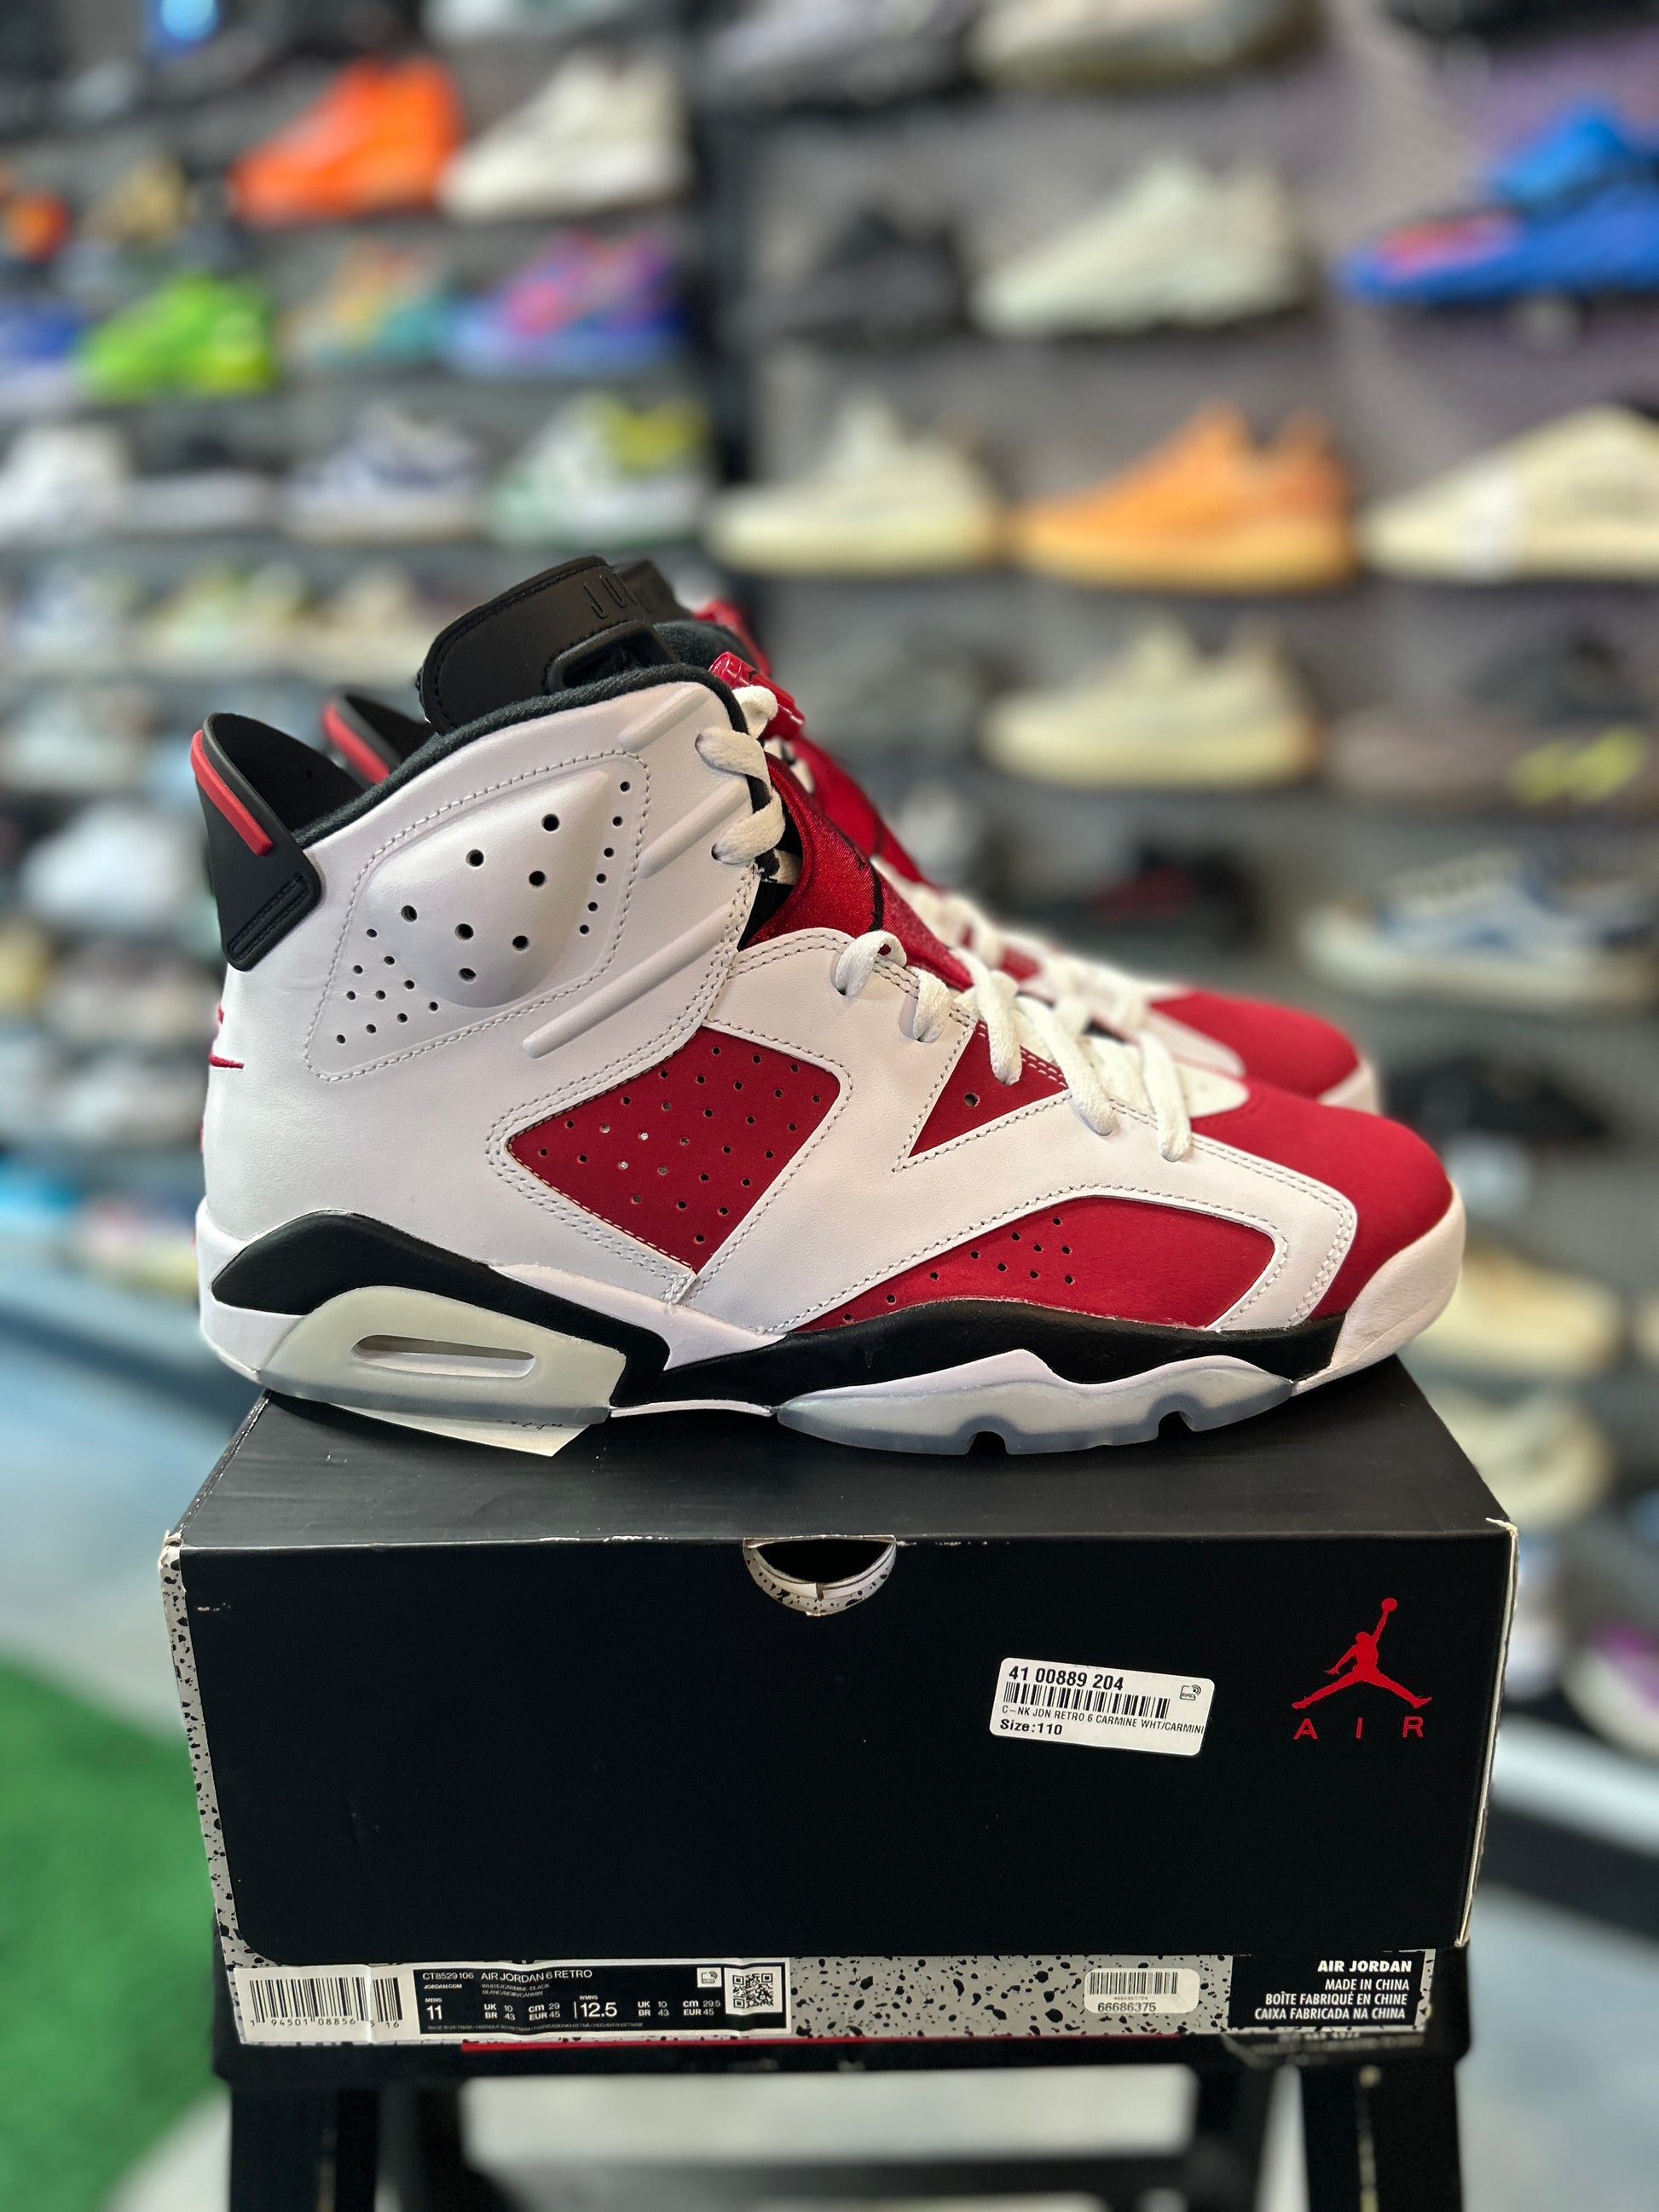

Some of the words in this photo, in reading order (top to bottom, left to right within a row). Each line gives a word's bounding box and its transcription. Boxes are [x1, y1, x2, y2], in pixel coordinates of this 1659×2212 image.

[1009, 1666, 1029, 1681] 41
[1035, 1667, 1088, 1687] 00889
[1092, 1673, 1124, 1690] 204
[1002, 1704, 1031, 1716] C-NK
[1032, 1708, 1052, 1718] JDN
[1054, 1710, 1085, 1722] RETRO
[1087, 1713, 1094, 1723] 6
[1095, 1714, 1138, 1727] CARMINE
[1000, 1718, 1063, 1736] Size:110
[1292, 1715, 1424, 1740] AIR
[1317, 1960, 1344, 1972] AIR
[1349, 1960, 1412, 1972] JORDAN
[481, 1972, 499, 1980] AIR
[500, 1972, 545, 1984] JORDAN
[554, 1969, 592, 1978] RETRO
[1325, 1978, 1357, 1991] MADE
[1360, 1978, 1373, 1990] IN
[1375, 1978, 1410, 1991] CHINA
[683, 2000, 699, 2008] cm
[1265, 1990, 1298, 2006] BOÎTE
[1299, 1991, 1354, 2007] FABRIQUÉ
[1356, 1993, 1371, 2005] EN
[1374, 1993, 1408, 2006] CHINE
[425, 2004, 442, 2021] 11
[504, 2004, 513, 2013] 10
[528, 2004, 545, 2013] cm
[548, 2002, 560, 2011] 29
[580, 2001, 618, 2019] 12.5
[638, 2008, 651, 2017] BR
[657, 2008, 670, 2017] 43
[702, 2008, 714, 2017] 45
[1097, 2001, 1157, 2013] 66686375
[484, 2011, 498, 2019] BR
[504, 2013, 516, 2021] 43
[529, 2013, 547, 2021] EUR
[548, 2010, 561, 2019] 45
[1254, 2007, 1287, 2020] CAIXA
[1289, 2007, 1350, 2020] FABRICADA
[1352, 2007, 1368, 2020] NA
[1372, 2007, 1406, 2019] CHINA
[271, 2018, 309, 2026] 94501
[318, 2018, 356, 2026] 08856
[385, 2019, 400, 2029] 16
